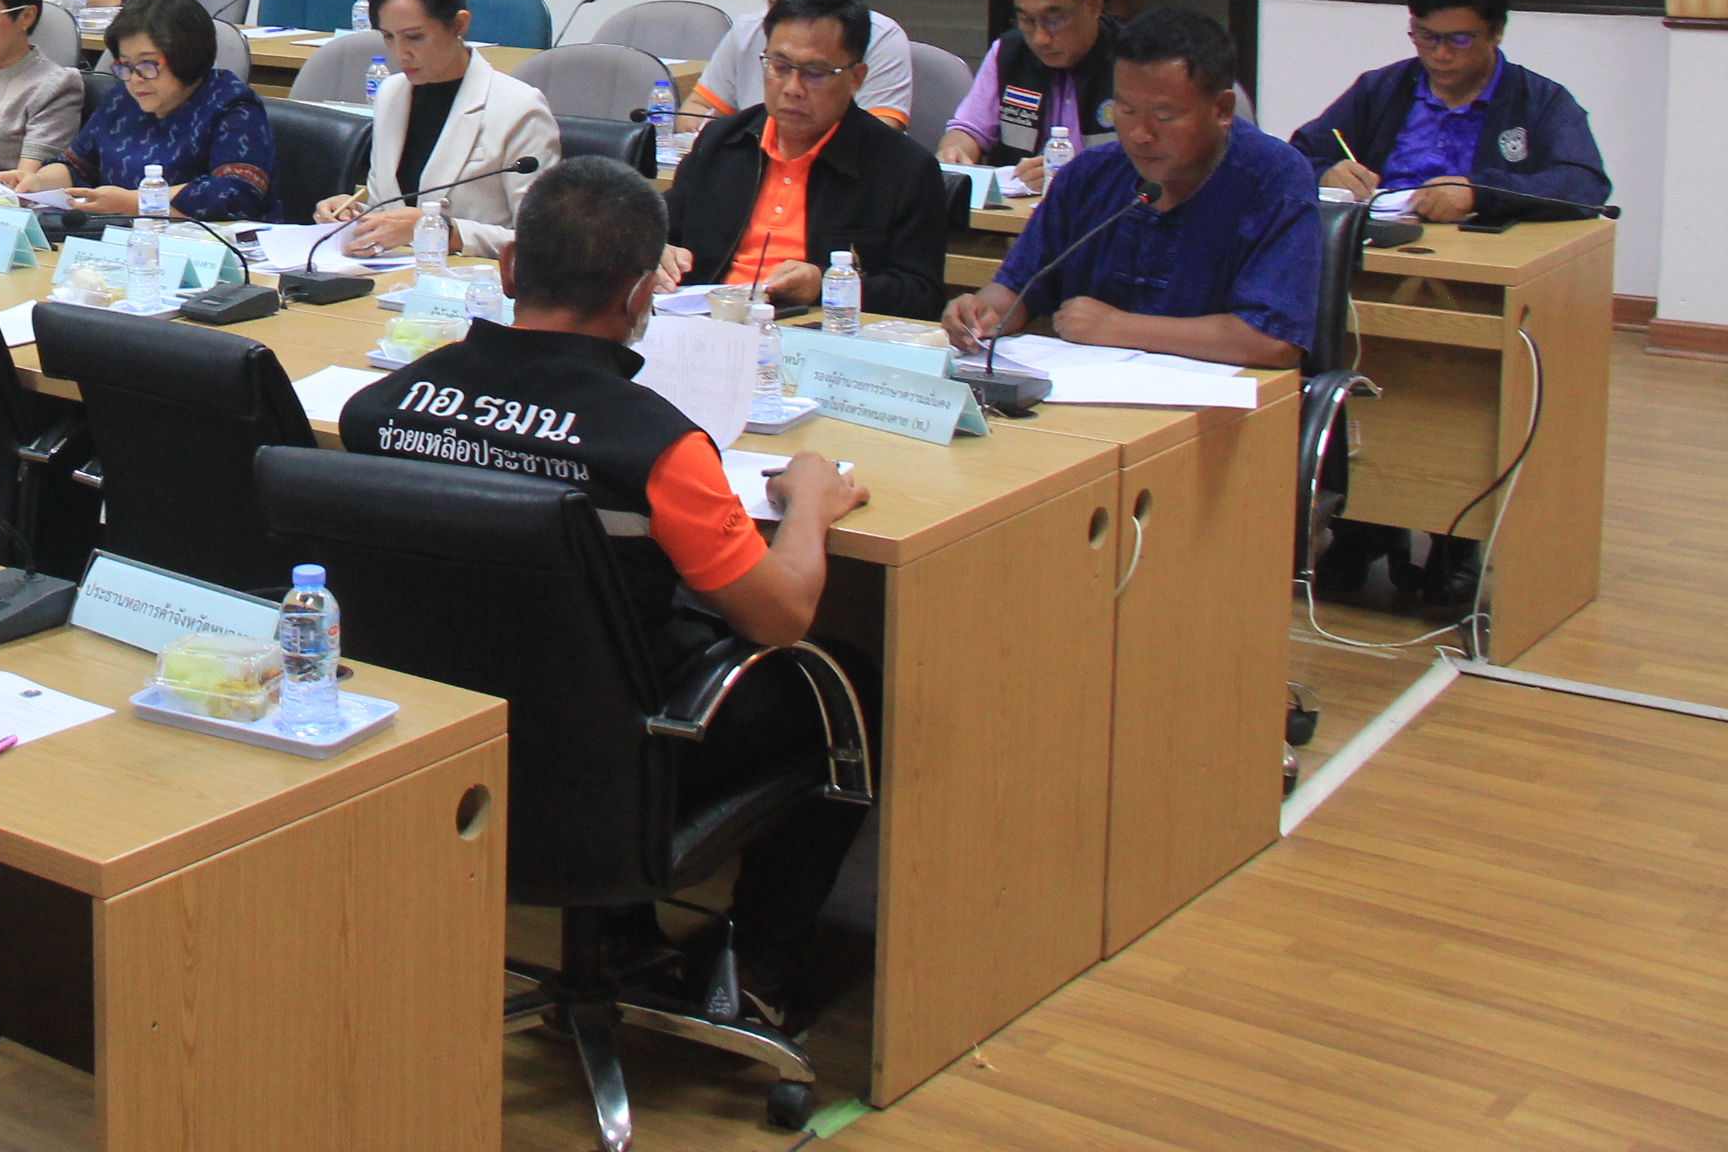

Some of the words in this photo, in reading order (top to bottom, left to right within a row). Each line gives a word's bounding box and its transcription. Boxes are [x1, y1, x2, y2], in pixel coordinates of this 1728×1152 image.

[398, 380, 582, 445] กอ.รมน.
[378, 419, 590, 482] ช่วยเหลือประชาชน
[85, 580, 251, 639] ประธานหอการค้าจังหวัดหน
